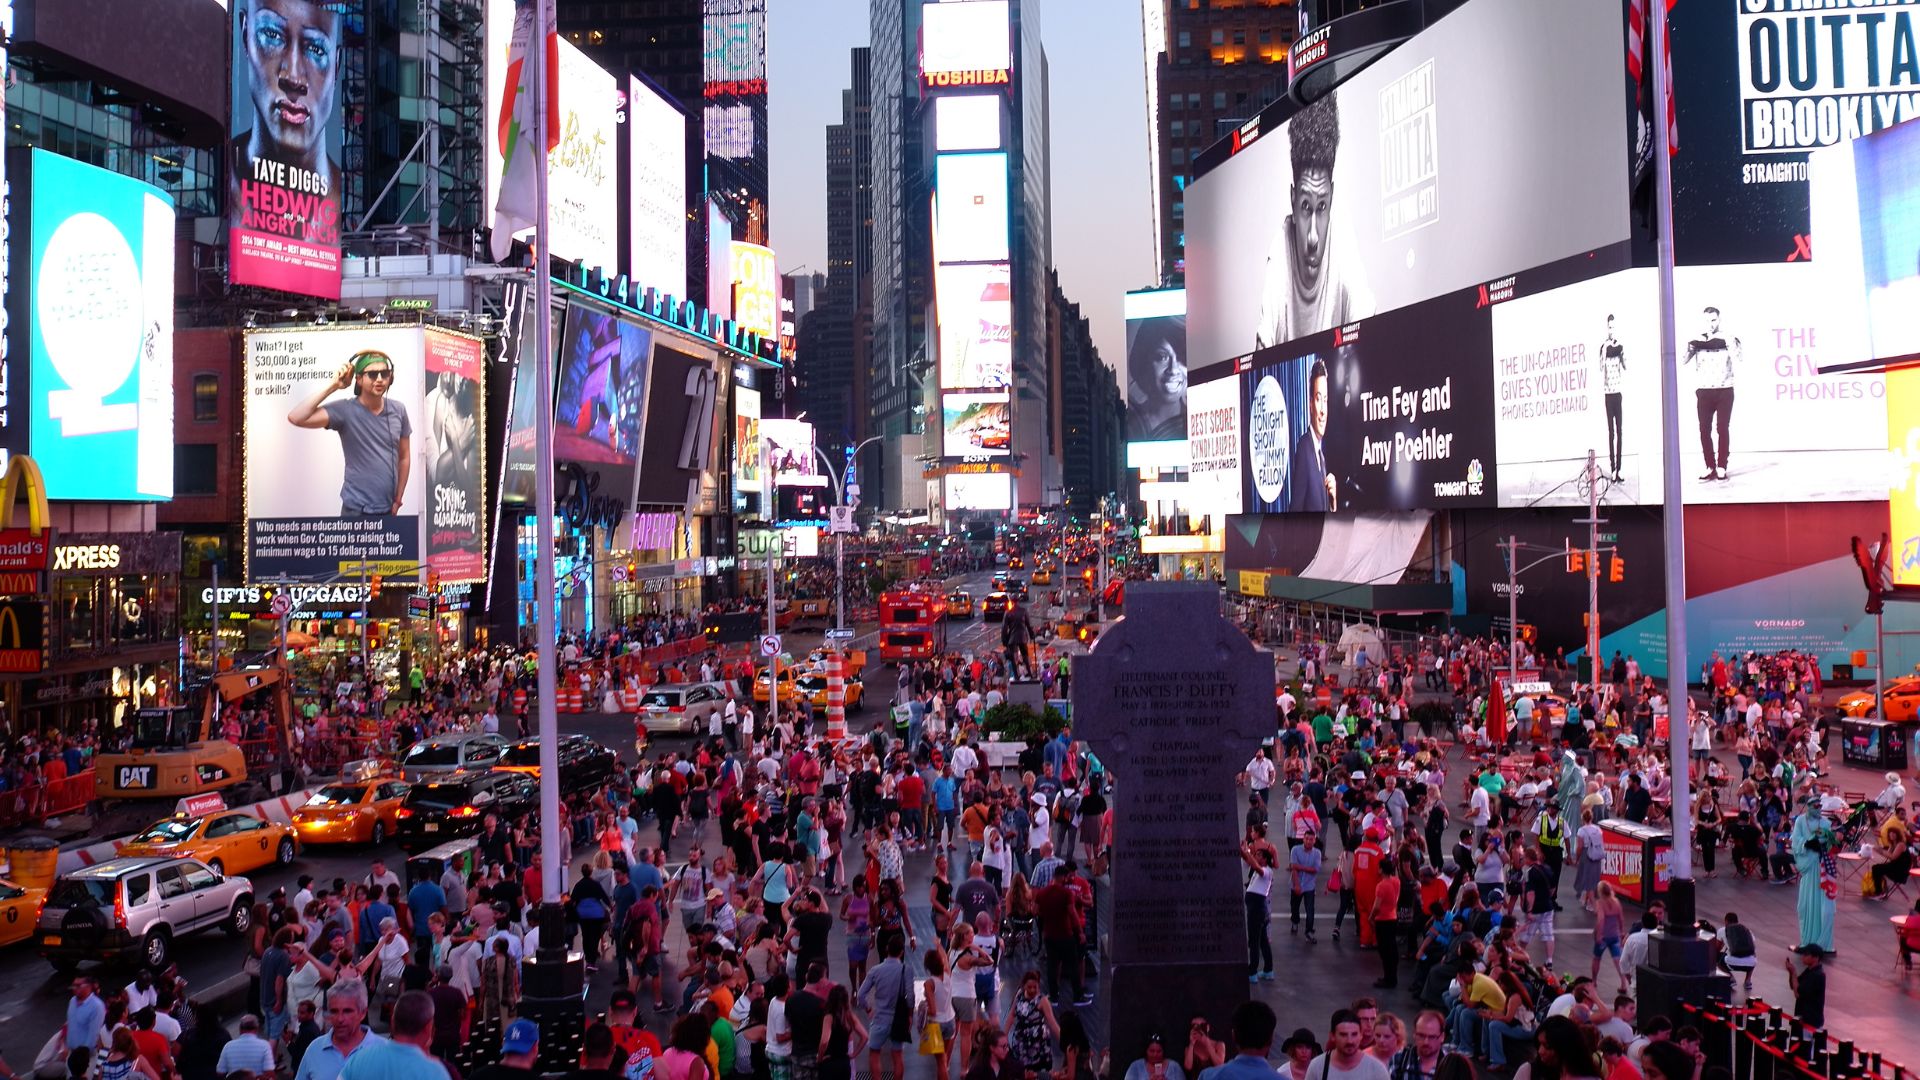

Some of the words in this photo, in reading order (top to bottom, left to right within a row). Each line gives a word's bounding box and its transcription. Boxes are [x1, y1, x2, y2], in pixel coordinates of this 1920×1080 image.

[1295, 26, 1331, 55] MARRIOTT
[1295, 43, 1327, 69] MARQUIS
[1749, 12, 1920, 92] OUTTA
[925, 70, 1008, 86] TOSHIBA
[1384, 112, 1434, 192] OUTTA
[253, 157, 285, 186] TAYE
[289, 166, 328, 196] DIGGS
[241, 179, 337, 226] HEDWIG
[241, 208, 298, 236] ANGRY
[302, 222, 337, 243] INCH
[1490, 277, 1515, 291] MARRIOTT
[1490, 288, 1513, 302] MARQUIS
[393, 300, 428, 308] LAMAR
[653, 288, 760, 355] BROADWAY
[1771, 327, 1816, 348] THE
[255, 341, 282, 351] What?
[288, 341, 303, 353] get
[255, 355, 289, 368] $30,000
[291, 357, 296, 366] a
[298, 356, 317, 368] year
[1500, 357, 1518, 376] THE
[1521, 343, 1586, 373] UN-CARRIER
[255, 370, 273, 380] with
[275, 372, 285, 380] no
[287, 369, 334, 382] experience
[1501, 377, 1532, 401] GIVES
[1534, 372, 1558, 396] YOU
[1560, 367, 1588, 392] NEW
[255, 387, 263, 395] or
[265, 384, 291, 396] skills?
[1776, 381, 1863, 400] PHONES
[1254, 394, 1266, 414] THE
[1360, 392, 1390, 421] Tina
[1392, 386, 1418, 423] Fey
[1421, 376, 1451, 413] and
[1502, 402, 1534, 421] PHONES
[1536, 400, 1548, 417] ON
[1550, 395, 1588, 415] DEMAND
[1191, 411, 1209, 437] BEST
[1210, 406, 1236, 432] SCORE!
[1254, 410, 1284, 433] TONIGHT
[1254, 431, 1276, 450] SHOW
[1361, 435, 1392, 471] Amy
[1395, 427, 1453, 463] Poehler
[963, 455, 992, 463] SONY
[1263, 448, 1285, 467] JIMMY
[1258, 467, 1284, 487] FALLON
[1434, 481, 1467, 497] TONIGHT
[1468, 482, 1483, 496] NBC
[435, 484, 466, 512] SPRING
[256, 521, 273, 532] Who
[276, 521, 299, 532] needs
[301, 523, 311, 531] an
[312, 519, 352, 531] education
[354, 521, 363, 530] or
[364, 519, 383, 530] hard
[433, 509, 476, 534] awakening
[256, 534, 276, 545] work
[277, 533, 299, 544] when
[300, 533, 317, 544] Gov.
[319, 533, 346, 543] Cuomo
[347, 533, 355, 543] is
[357, 532, 384, 545] raising
[386, 531, 400, 542] the
[631, 513, 676, 550] FOREVER
[53, 545, 120, 571] XPRESS
[256, 546, 292, 557] minimum
[293, 547, 315, 559] wage
[317, 546, 326, 556] to
[328, 545, 338, 556] 15
[339, 545, 367, 556] dollars
[368, 546, 378, 556] an
[380, 544, 403, 555] hour?
[202, 587, 260, 604] GIFTS
[1492, 582, 1524, 595] VORNDO
[229, 611, 250, 619] Nikon
[1754, 619, 1805, 628] VORNADO
[1121, 672, 1177, 681] LIEUTENANT
[1181, 671, 1226, 681] COLONEL
[1114, 685, 1171, 698] FRANCIS
[1190, 683, 1238, 697] DUFFY
[1130, 717, 1180, 727] CATHOLIC
[1186, 716, 1221, 726] PRIEST
[1152, 741, 1200, 751] CHAPLAIN
[1179, 754, 1223, 764] INFANTRY
[120, 767, 150, 788] CAT
[1143, 768, 1163, 776] OLD
[1144, 794, 1162, 803] LIFE
[1167, 793, 1180, 803] OF
[1184, 792, 1224, 802] SERVICE
[1129, 814, 1153, 823] GOD
[1156, 814, 1177, 822] AND
[1180, 813, 1227, 822] COUNTRY
[1116, 850, 1136, 859] NEW
[1164, 850, 1206, 858] NATIONAL
[1209, 848, 1241, 857] GUARD
[1139, 862, 1180, 870] MEXICAN
[1182, 861, 1217, 870] BORDER
[1600, 850, 1624, 876] ERSEY
[1151, 873, 1182, 881] WORLD
[1187, 873, 1208, 881] WAR
